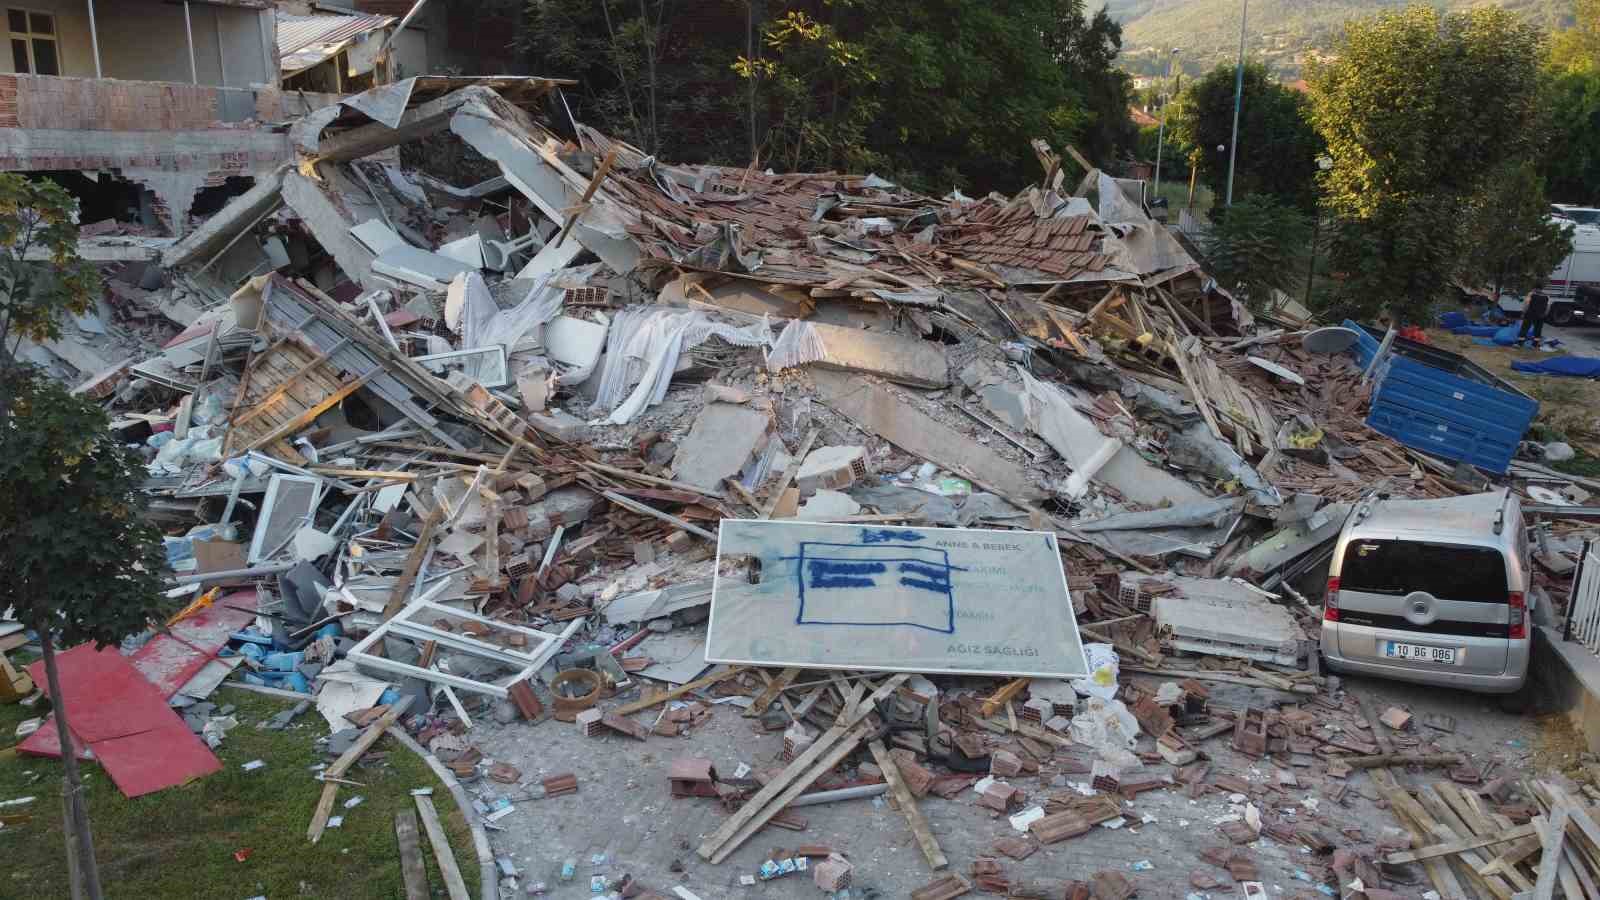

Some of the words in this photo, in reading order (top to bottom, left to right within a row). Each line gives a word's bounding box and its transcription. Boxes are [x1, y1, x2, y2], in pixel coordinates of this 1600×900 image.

[935, 540, 969, 549] ANNE
[983, 542, 1024, 552] BEBEK
[1397, 645, 1409, 655] 10
[1414, 646, 1427, 657] BG
[1432, 648, 1451, 660] 086
